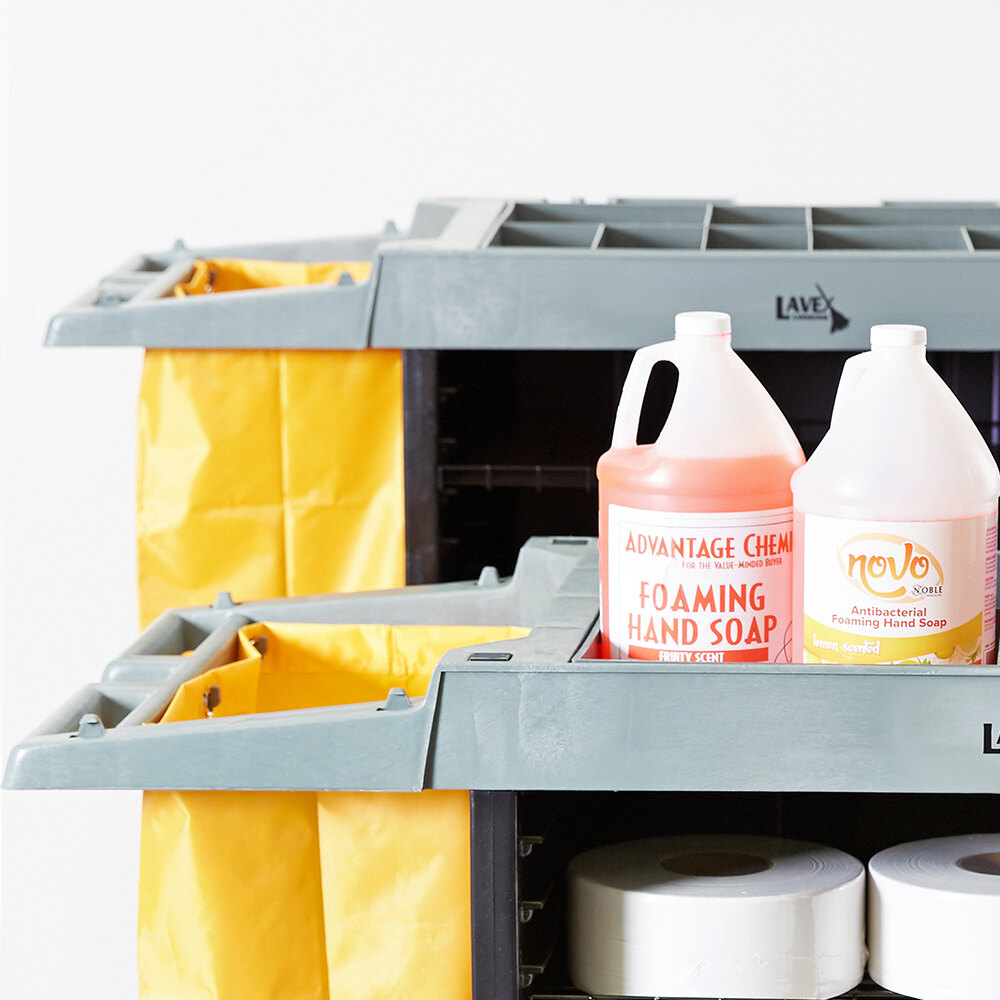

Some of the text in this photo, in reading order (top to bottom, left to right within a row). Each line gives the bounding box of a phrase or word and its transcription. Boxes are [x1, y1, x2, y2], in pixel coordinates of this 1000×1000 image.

[776, 285, 835, 319] LAVEX
[625, 530, 735, 559] ADVANTAGE
[682, 561, 696, 569] FOR
[699, 561, 711, 569] THE
[765, 558, 783, 567] BUYER
[639, 581, 765, 613] FOAMING
[912, 585, 943, 596] NOBLE
[851, 605, 927, 617] Antibacterial
[628, 613, 777, 646] HAND SOAP
[832, 614, 947, 629] Foaming Hand Soap
[813, 633, 881, 655] lemon scented
[659, 651, 724, 662] FRUITY SCENT
